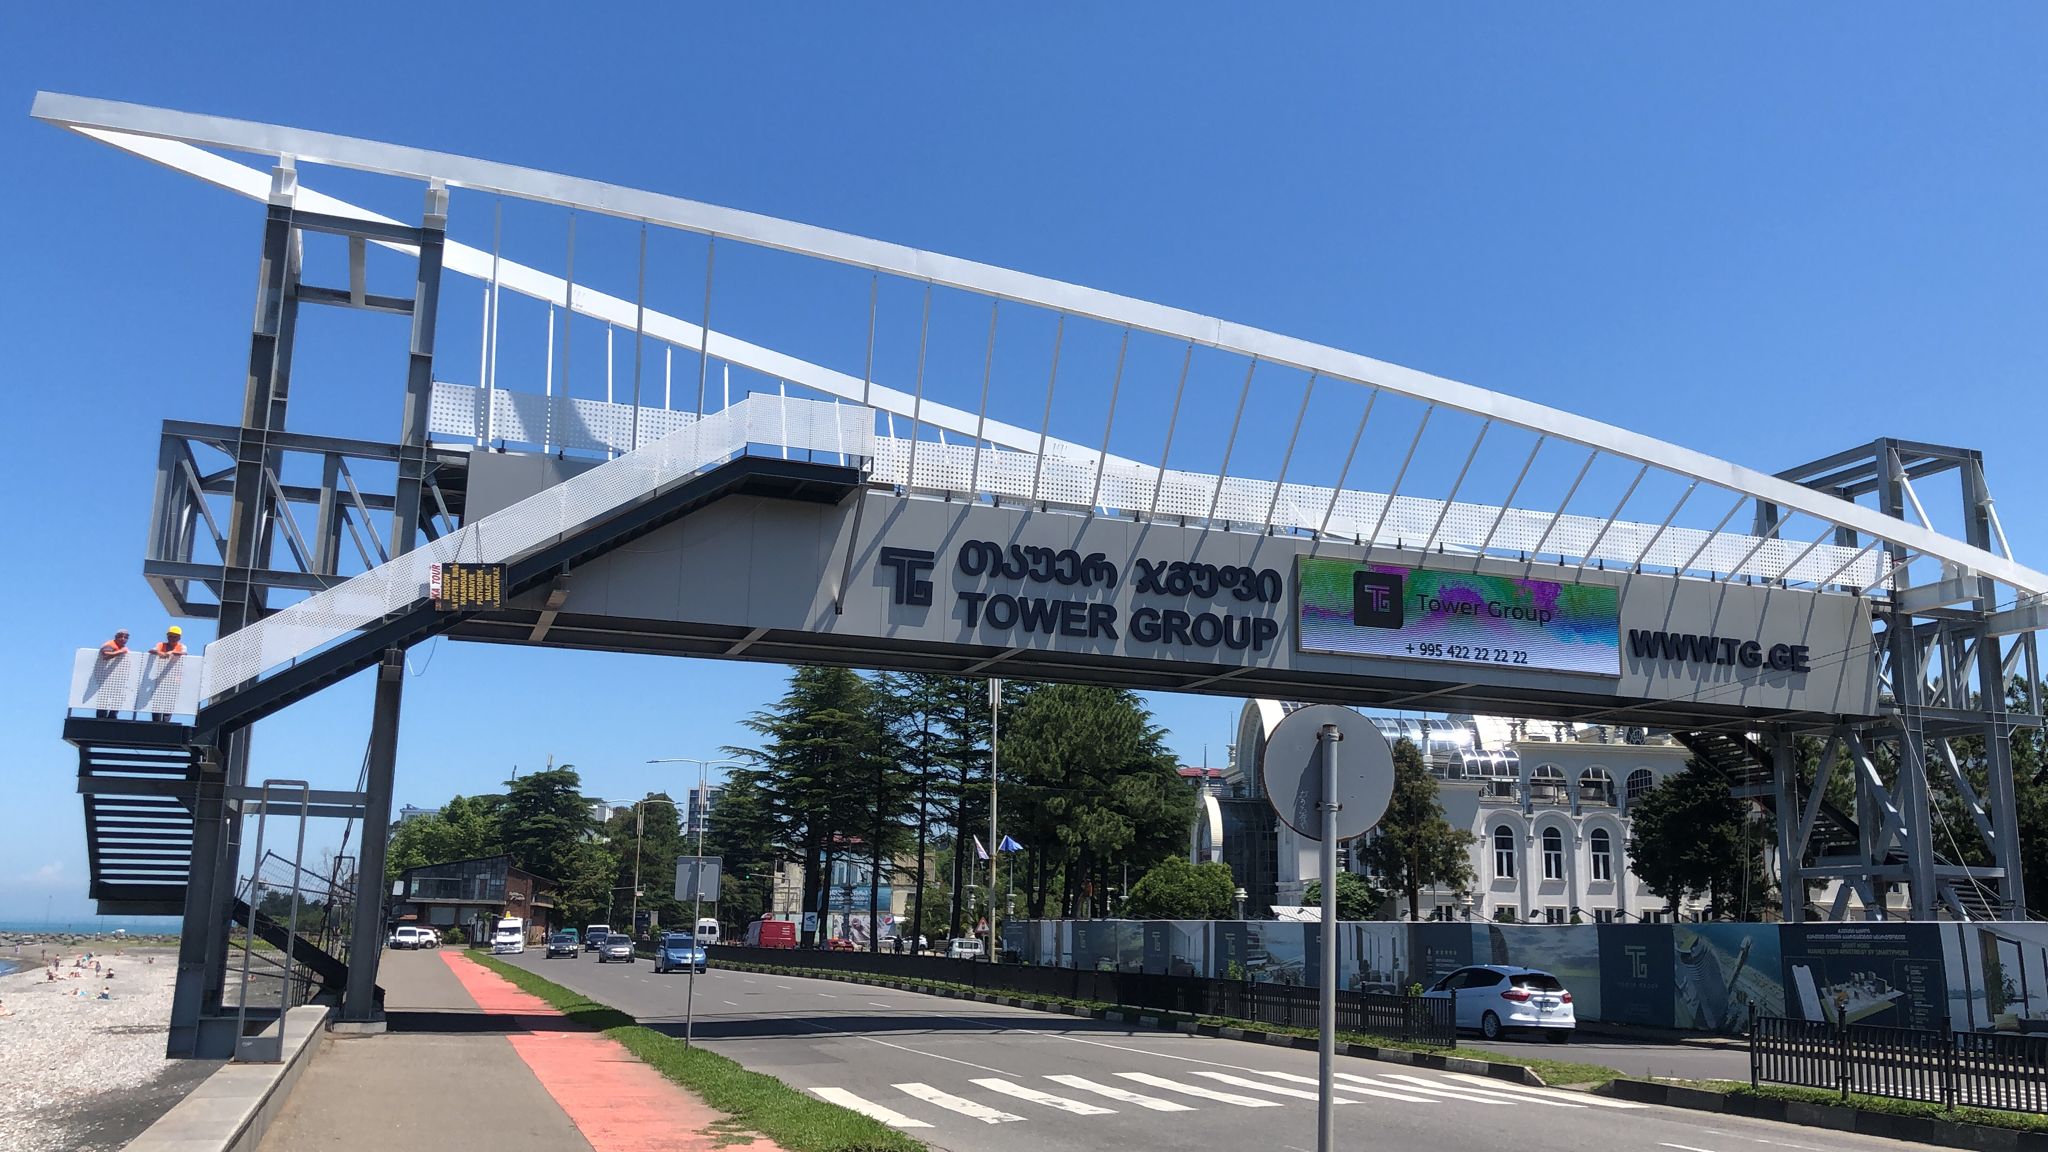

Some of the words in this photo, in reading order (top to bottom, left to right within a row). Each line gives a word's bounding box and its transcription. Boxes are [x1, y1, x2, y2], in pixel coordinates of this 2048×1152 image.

[431, 564, 441, 585] TOUR
[443, 573, 451, 600] MOSCOW
[484, 574, 492, 601] NALCHIK
[492, 566, 500, 608] VLADIKAVKAZ
[959, 540, 1118, 589] თაუერ
[1135, 558, 1283, 604] ჯგუფი
[958, 591, 1119, 640] TOWER
[1130, 607, 1279, 651] GROUP
[1416, 594, 1482, 616] Tower
[1488, 601, 1552, 625] Group
[1419, 643, 1443, 656] 995
[1447, 645, 1470, 659] 422
[1474, 647, 1489, 661] 22
[1494, 649, 1509, 663] 22
[1513, 650, 1528, 664] 22
[1630, 629, 1811, 672] WWW.TG.GE
